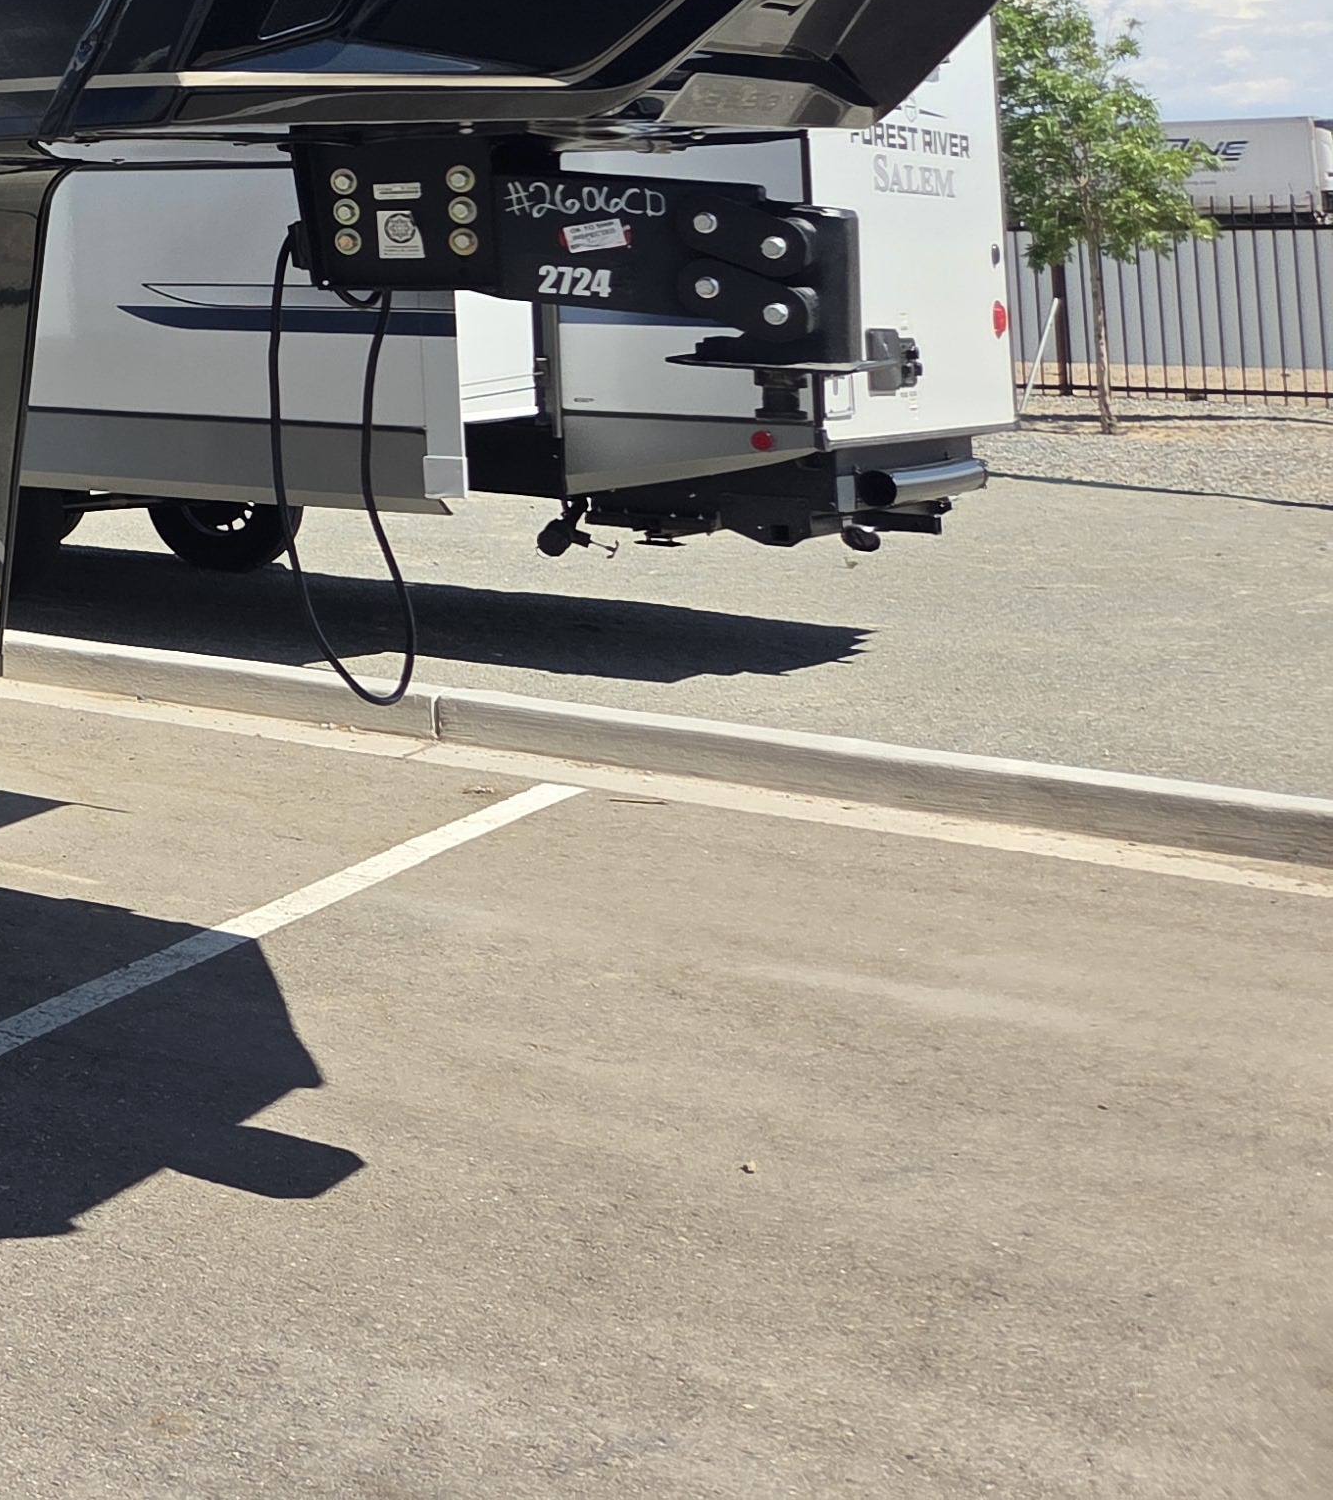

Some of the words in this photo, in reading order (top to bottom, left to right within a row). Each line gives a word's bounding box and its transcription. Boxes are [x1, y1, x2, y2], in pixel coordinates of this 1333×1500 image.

[921, 129, 970, 158] RIVER
[874, 153, 956, 198] SALEM
[504, 181, 666, 218] #2606CD
[538, 265, 612, 297] 2724
